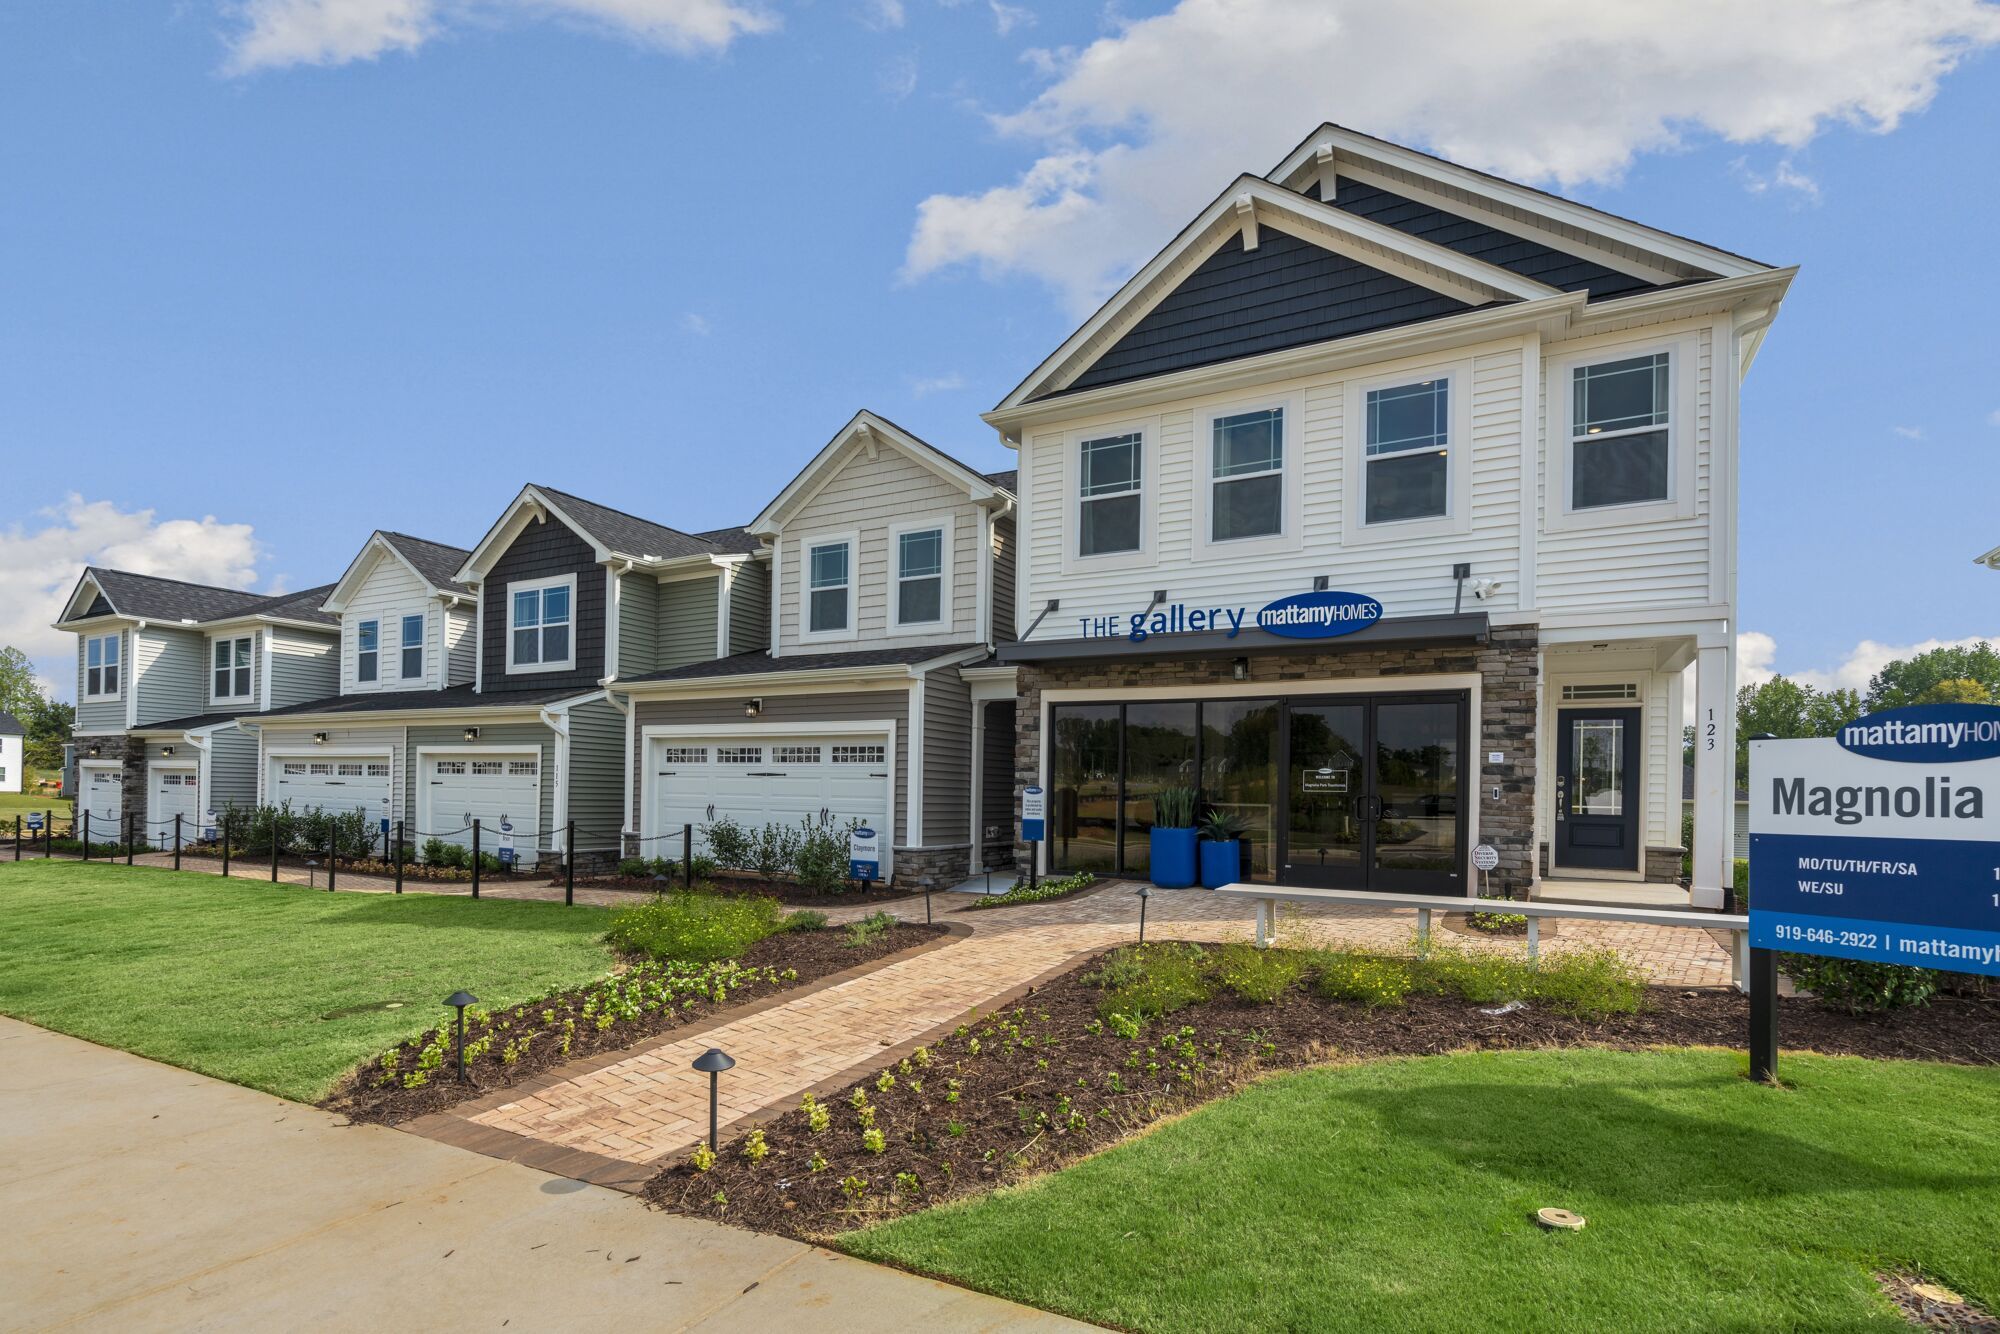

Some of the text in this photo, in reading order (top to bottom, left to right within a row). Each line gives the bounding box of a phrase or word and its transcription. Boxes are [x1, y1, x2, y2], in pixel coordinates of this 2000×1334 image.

[1079, 604, 1246, 643] THE gallery
[1261, 603, 1378, 627] mattamyHOMES
[1706, 708, 1716, 751] 123
[1772, 776, 1984, 825] Magnolia
[1798, 857, 1918, 875] MO/TU/TH/FR/SA
[1798, 880, 1843, 895] WE/SU
[1775, 924, 1877, 949] 919-646-2922
